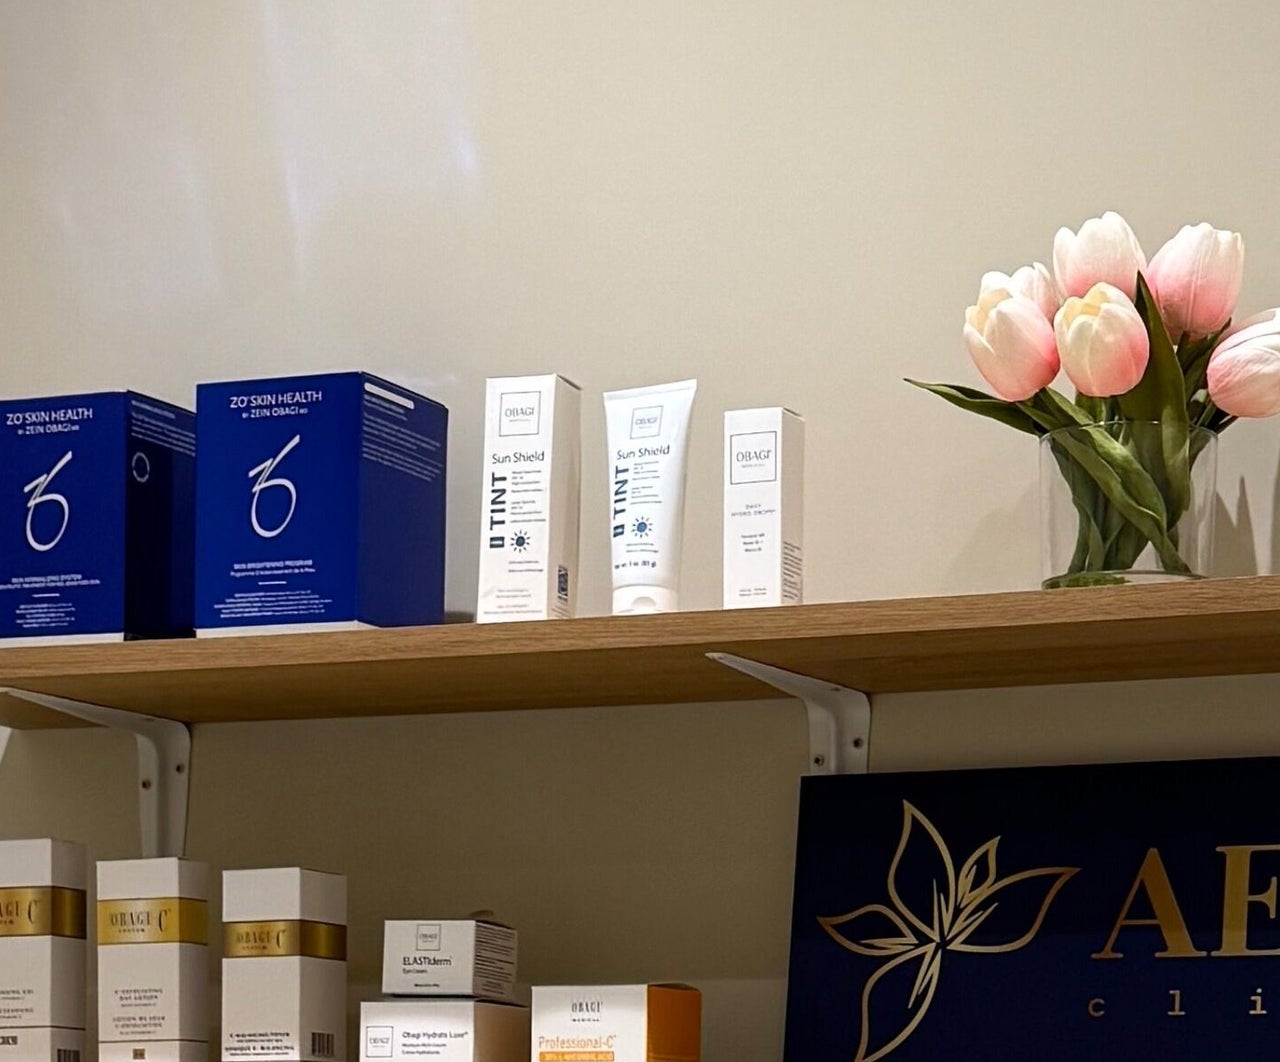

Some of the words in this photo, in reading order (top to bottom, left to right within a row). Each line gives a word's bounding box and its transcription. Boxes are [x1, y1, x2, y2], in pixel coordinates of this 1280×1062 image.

[229, 396, 247, 408] ZO
[249, 394, 276, 406] SKIN
[278, 390, 322, 404] HEALTH
[6, 412, 23, 425] ZO
[25, 411, 49, 424] SKIN
[51, 407, 93, 422] HEALTH
[250, 408, 270, 418] ZEIN
[492, 453, 511, 464] Sun
[513, 451, 545, 463] Shield
[617, 449, 635, 460] Sun
[638, 445, 670, 458] Shield
[736, 449, 771, 462] OBAGI
[613, 465, 629, 520] TINT
[489, 472, 507, 531] TINT
[110, 911, 150, 926] OBAGI
[571, 1001, 600, 1013] OBAGI
